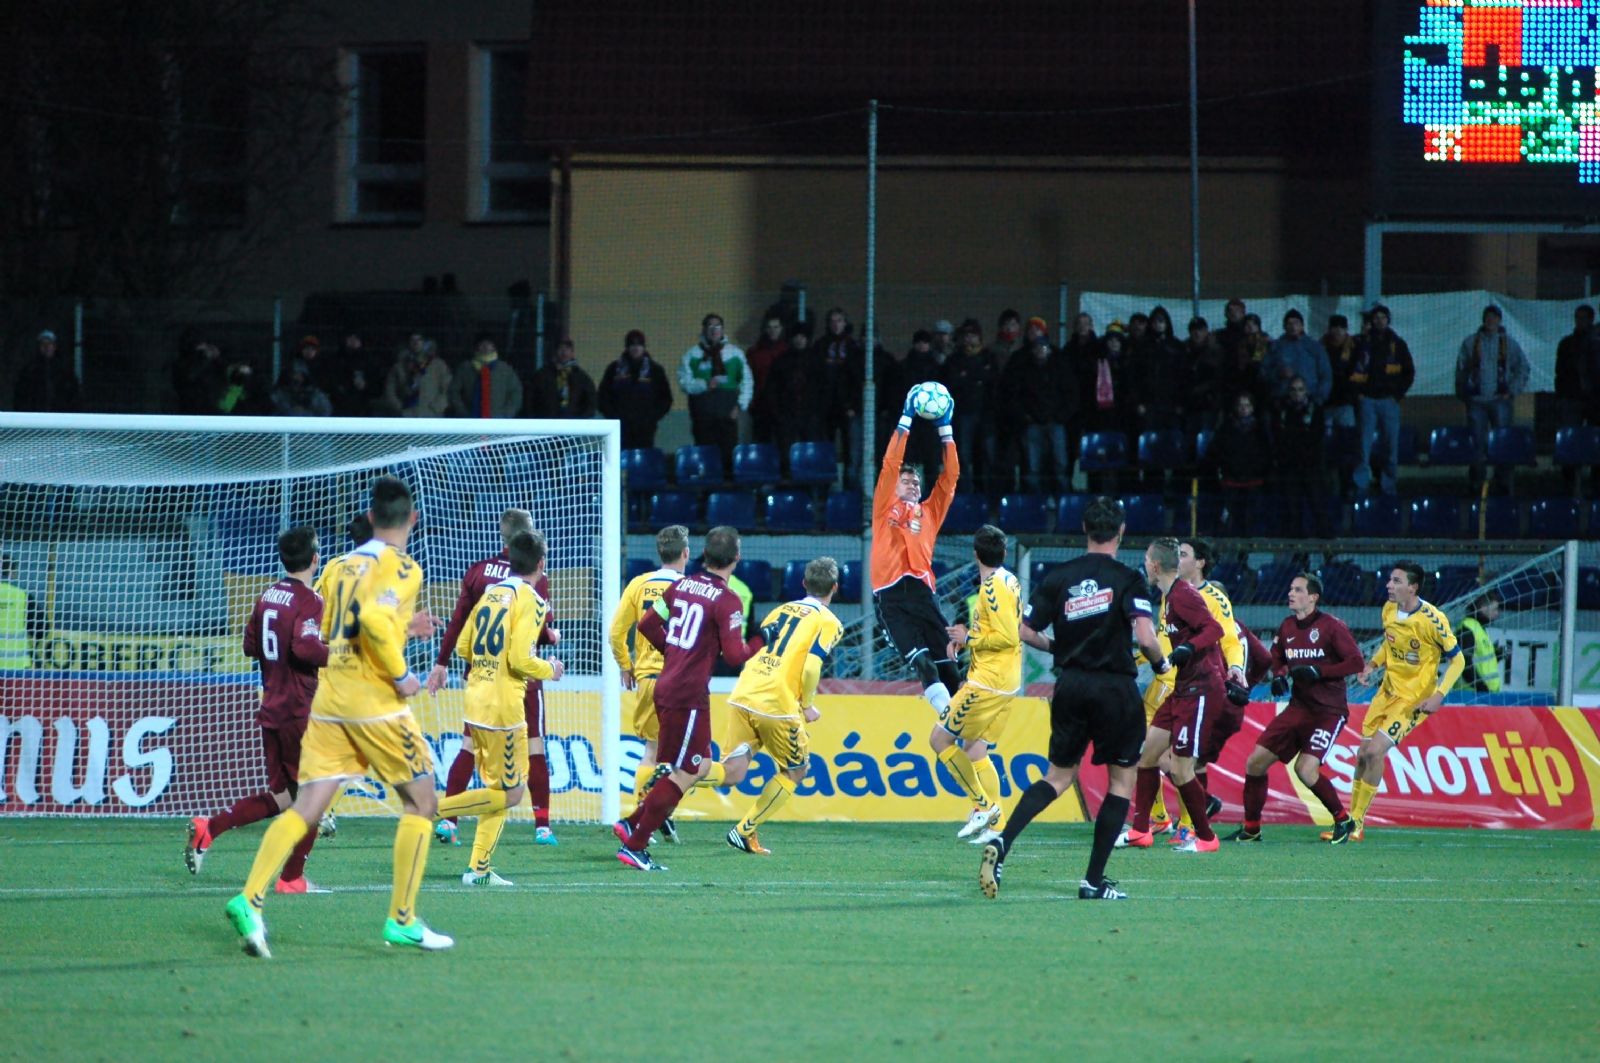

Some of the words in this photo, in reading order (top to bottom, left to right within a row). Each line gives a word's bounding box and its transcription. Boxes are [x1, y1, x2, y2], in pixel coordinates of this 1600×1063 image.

[263, 609, 279, 661] 6
[473, 606, 508, 657] 26
[666, 598, 704, 650] 20
[766, 612, 802, 657] 11
[1285, 648, 1326, 659] FORTUNA
[1178, 726, 1189, 745] 4
[1310, 729, 1332, 749] 25
[1388, 721, 1401, 736] 8
